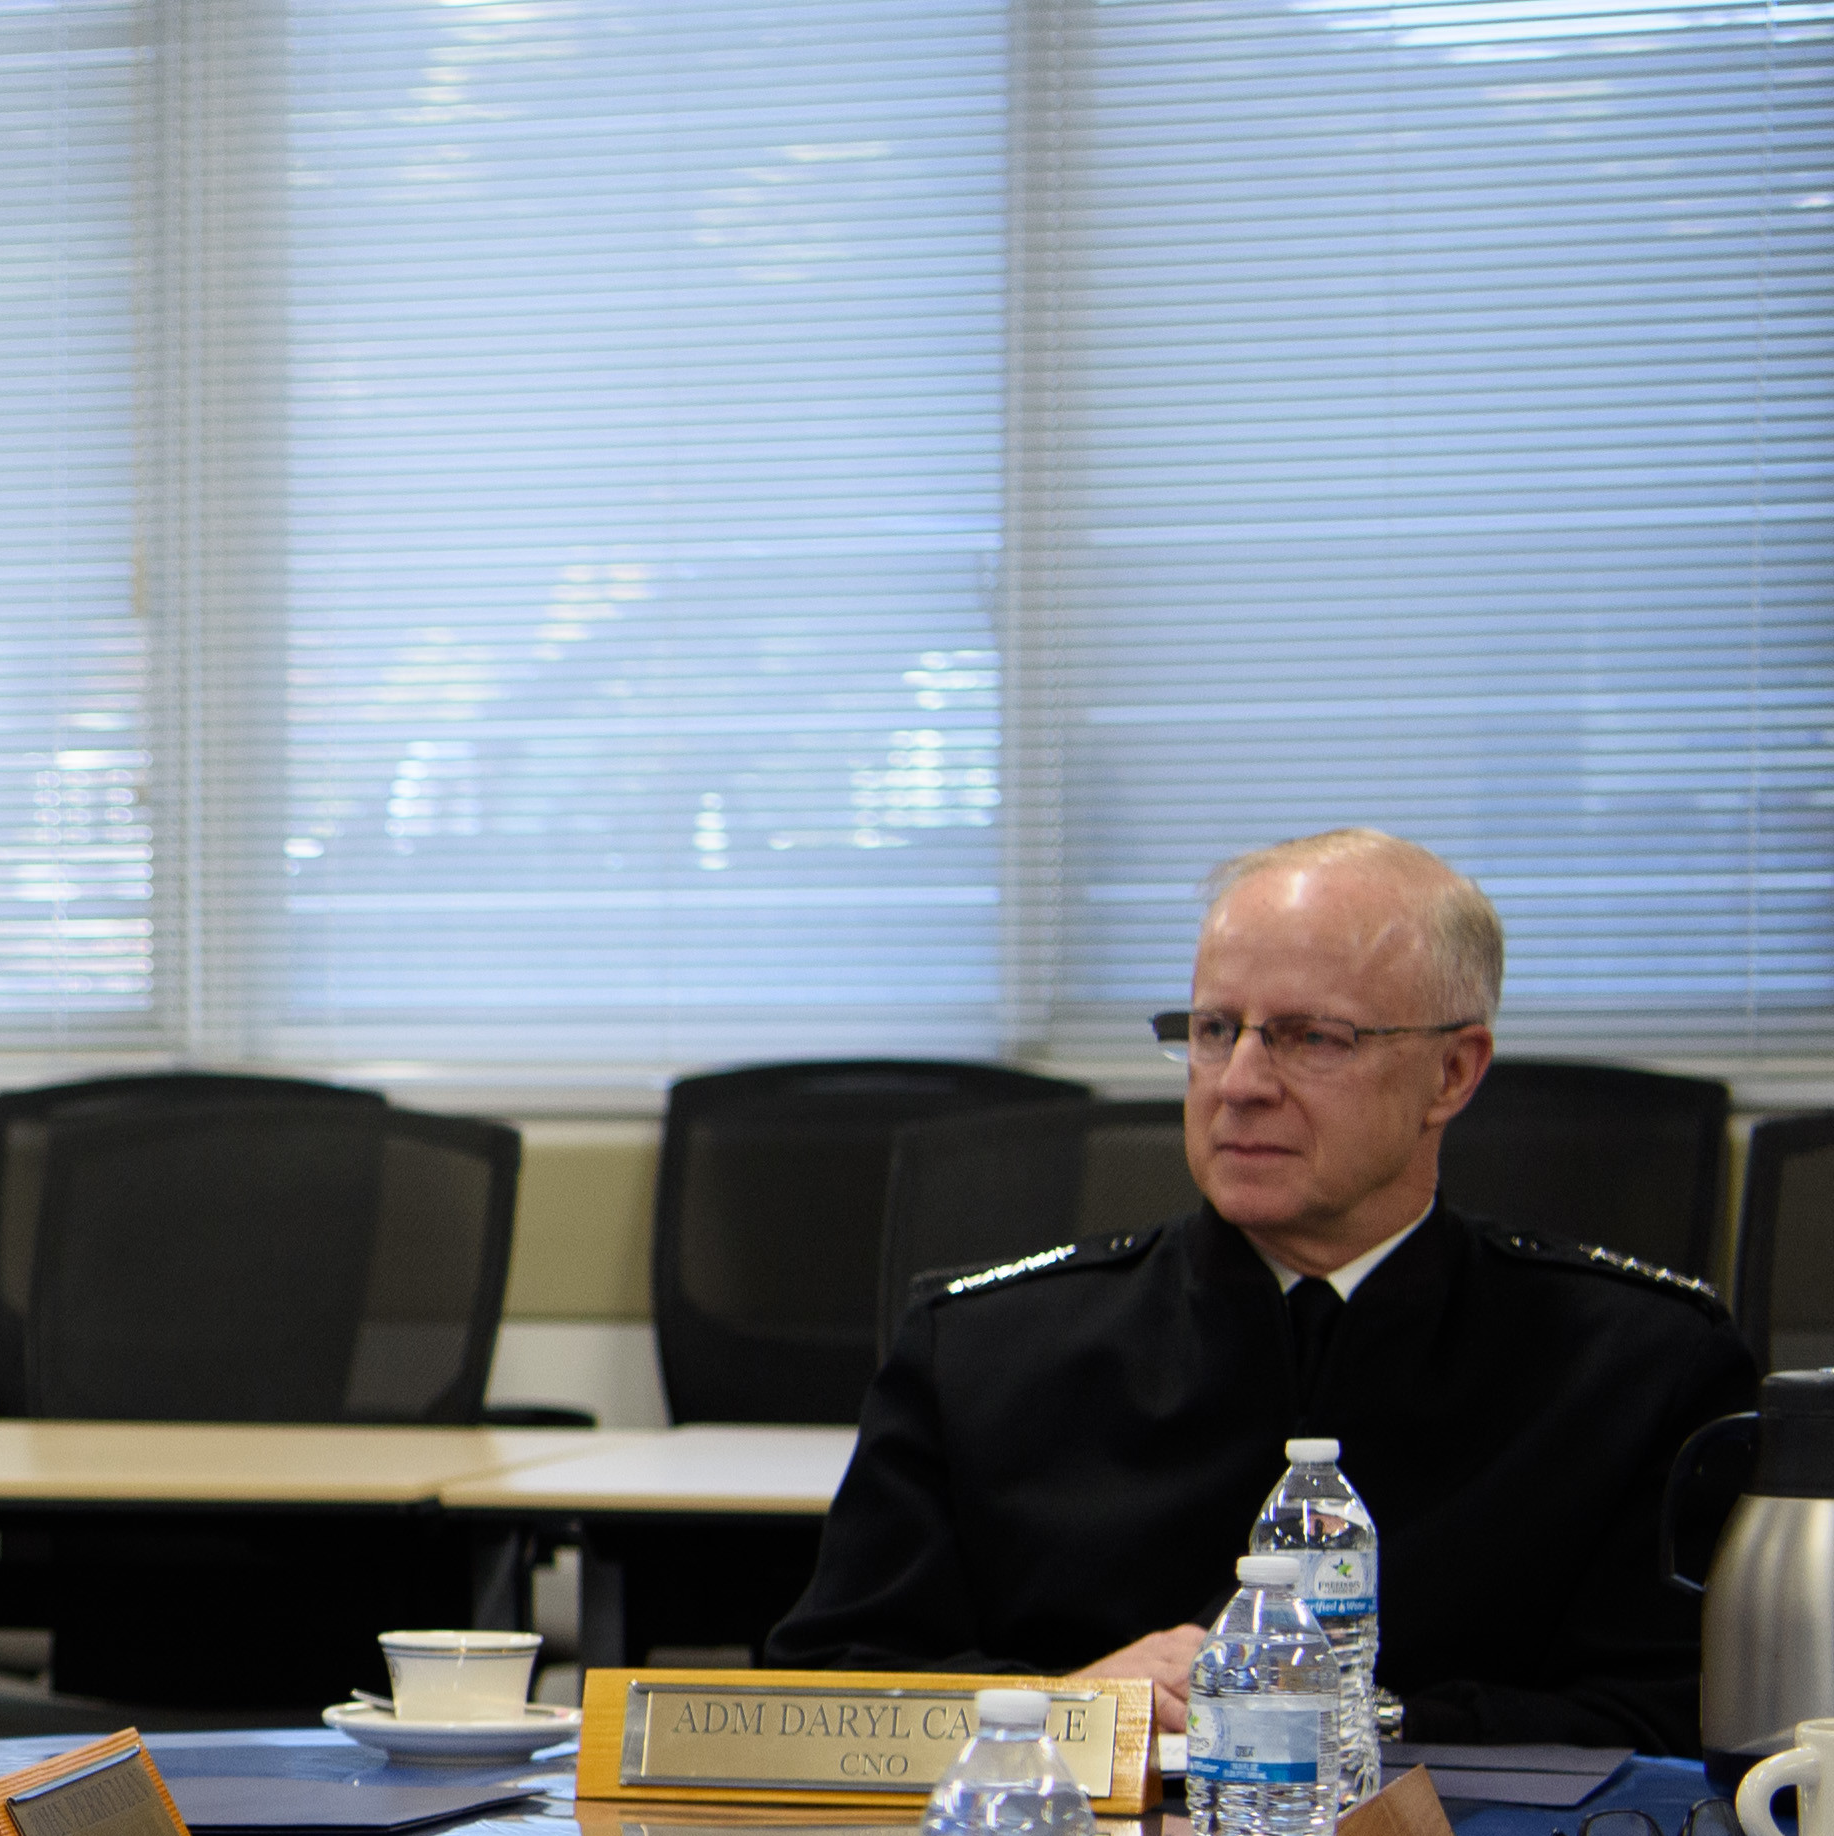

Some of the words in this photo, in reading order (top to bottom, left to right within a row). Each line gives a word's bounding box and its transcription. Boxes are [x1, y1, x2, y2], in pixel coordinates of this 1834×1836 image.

[672, 1701, 766, 1735] ADM
[778, 1703, 912, 1738] DARYL
[922, 1706, 1089, 1742] CALE
[839, 1752, 909, 1777] CNO
